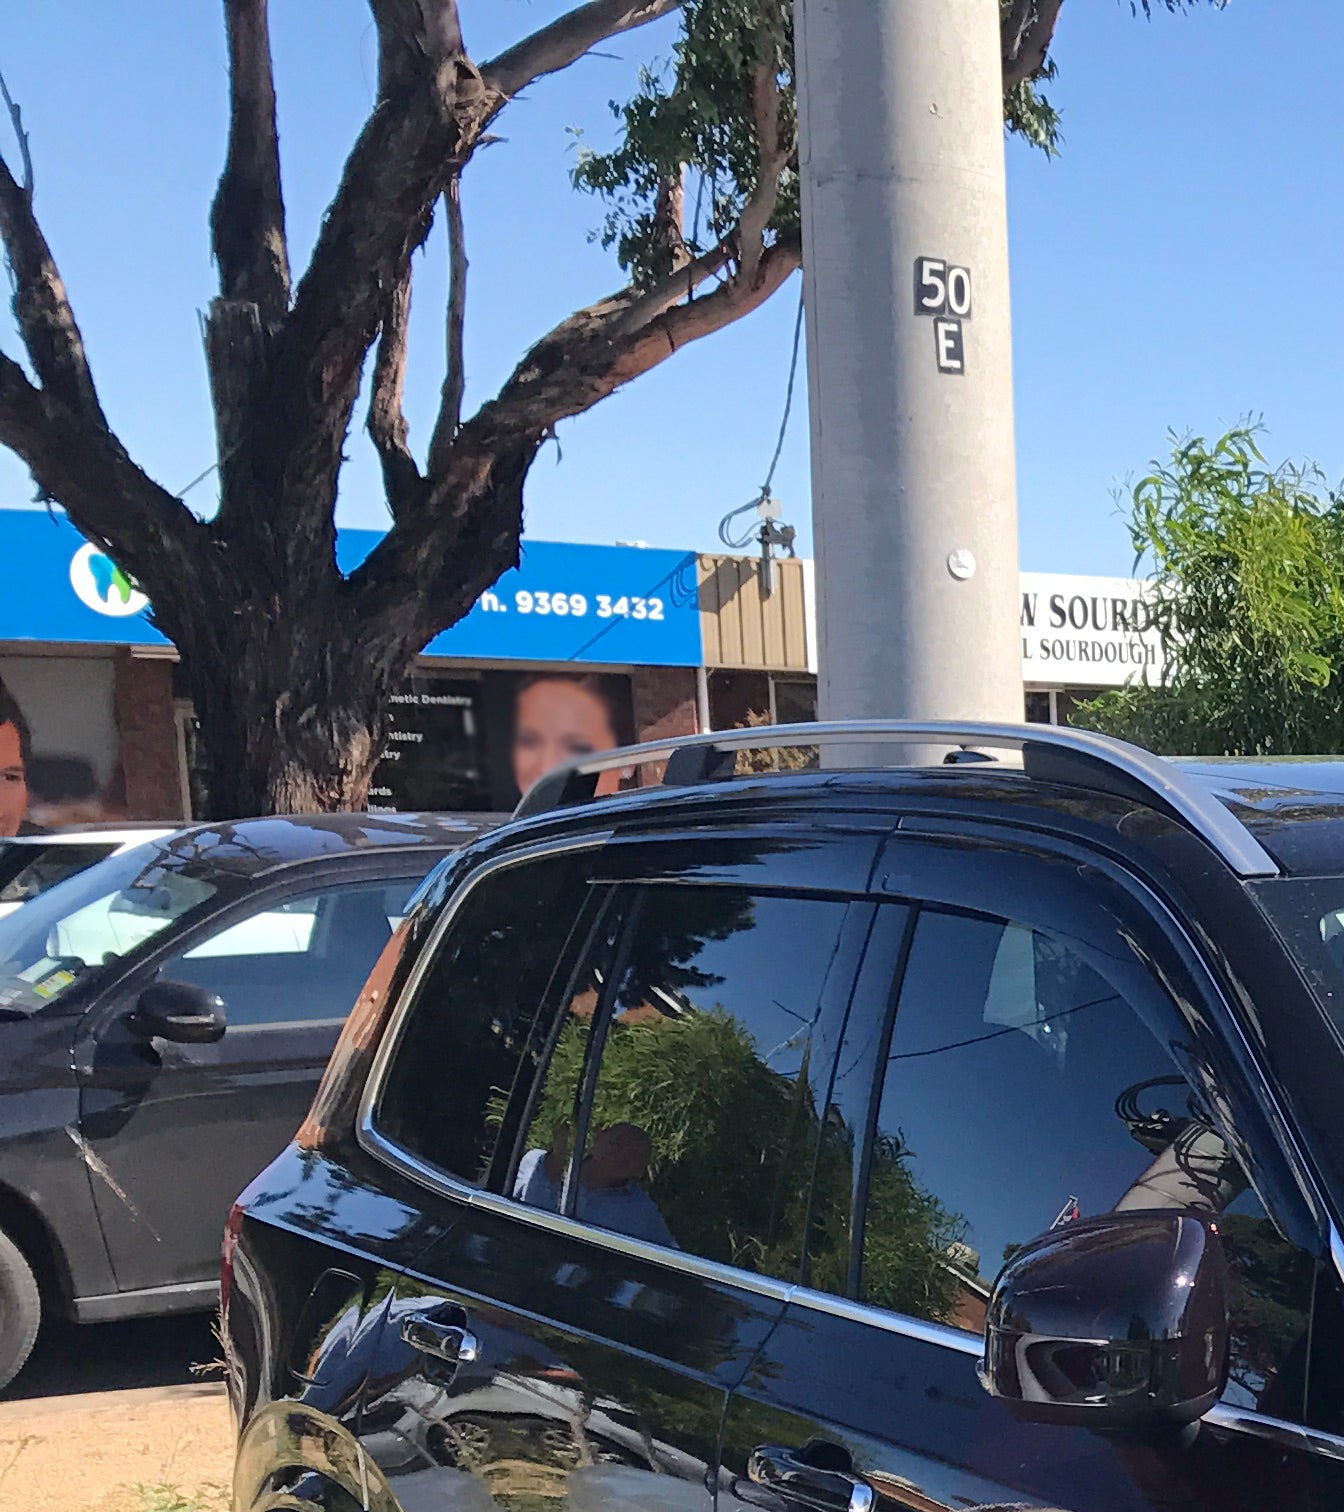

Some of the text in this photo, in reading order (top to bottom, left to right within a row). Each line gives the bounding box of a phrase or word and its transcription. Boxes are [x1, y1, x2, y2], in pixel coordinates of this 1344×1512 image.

[921, 262, 971, 315] 50
[938, 323, 961, 370] E
[481, 590, 665, 620] h. 9369 3432
[1039, 638, 1156, 665] SOURDOUGH
[421, 694, 472, 707] Dentistry
